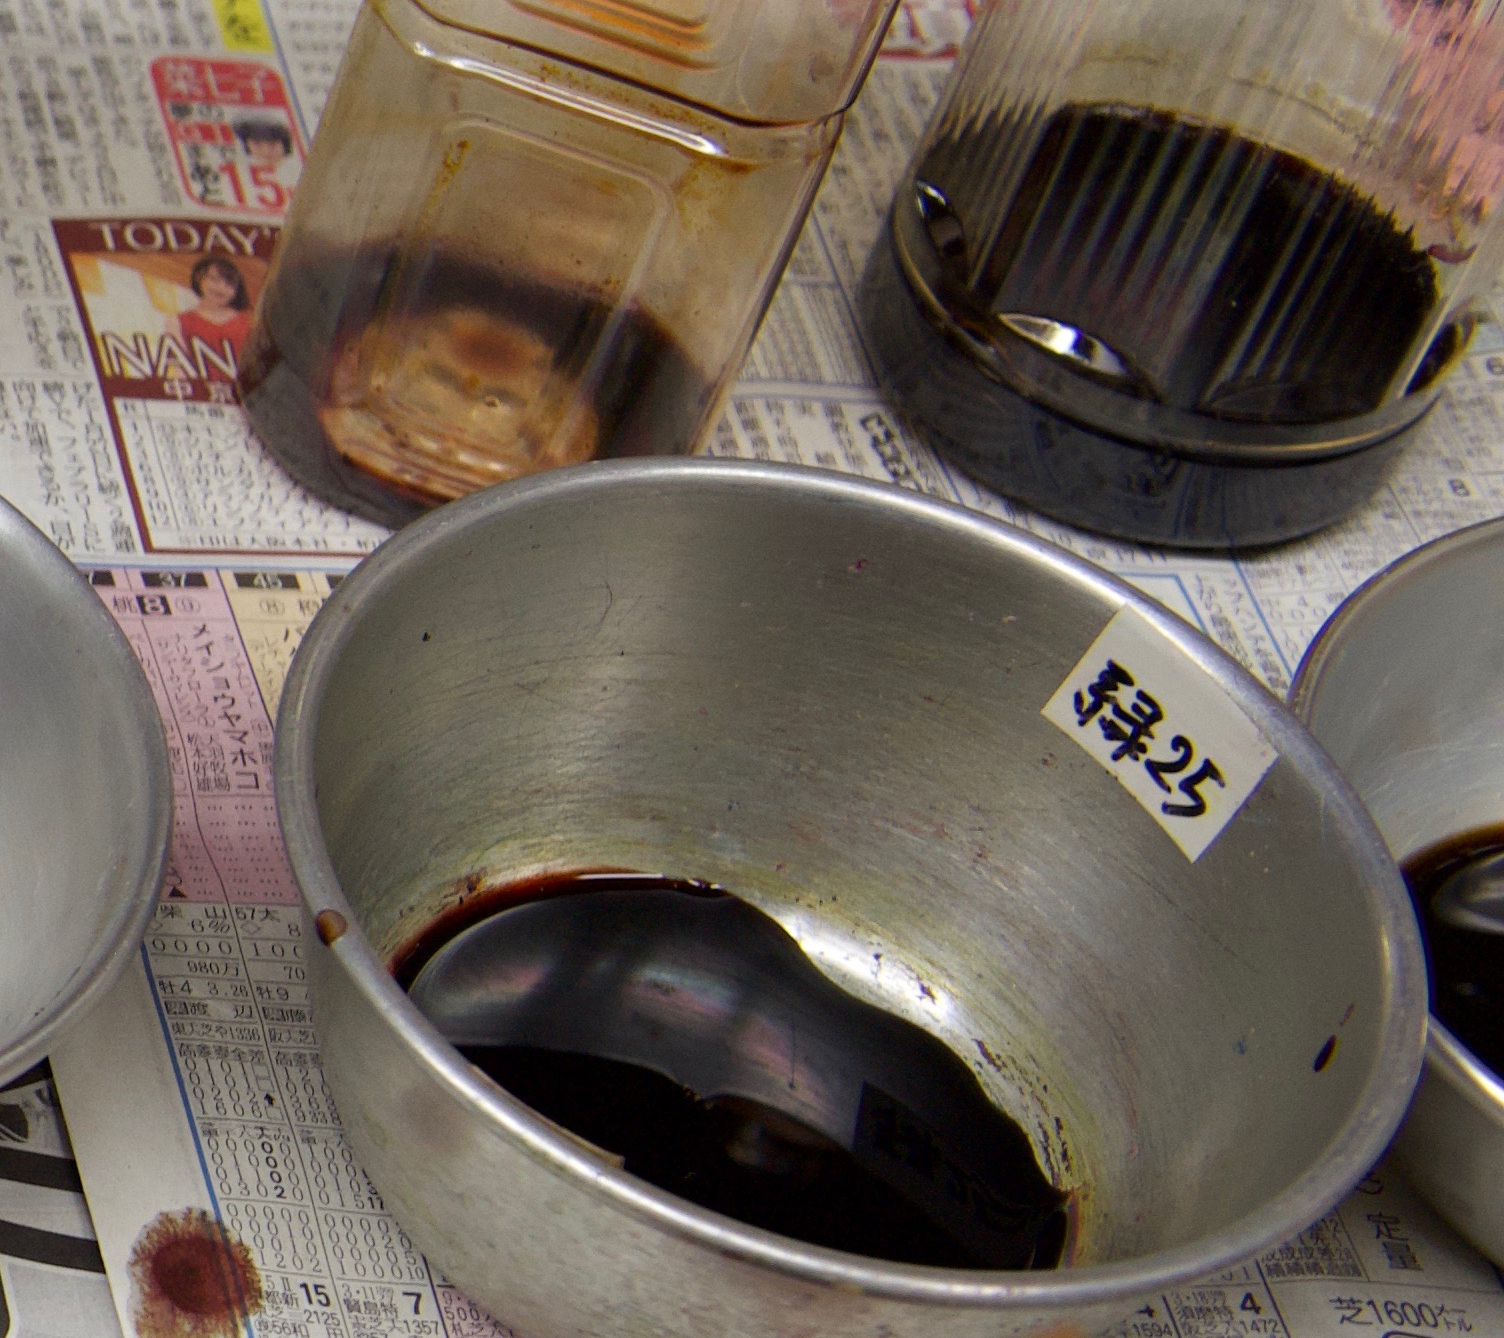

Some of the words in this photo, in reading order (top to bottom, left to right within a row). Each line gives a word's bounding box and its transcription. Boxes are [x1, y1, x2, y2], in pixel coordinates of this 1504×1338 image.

[299, 1281, 332, 1309] 15
[402, 1291, 424, 1316] 7
[1239, 1292, 1262, 1317] 4
